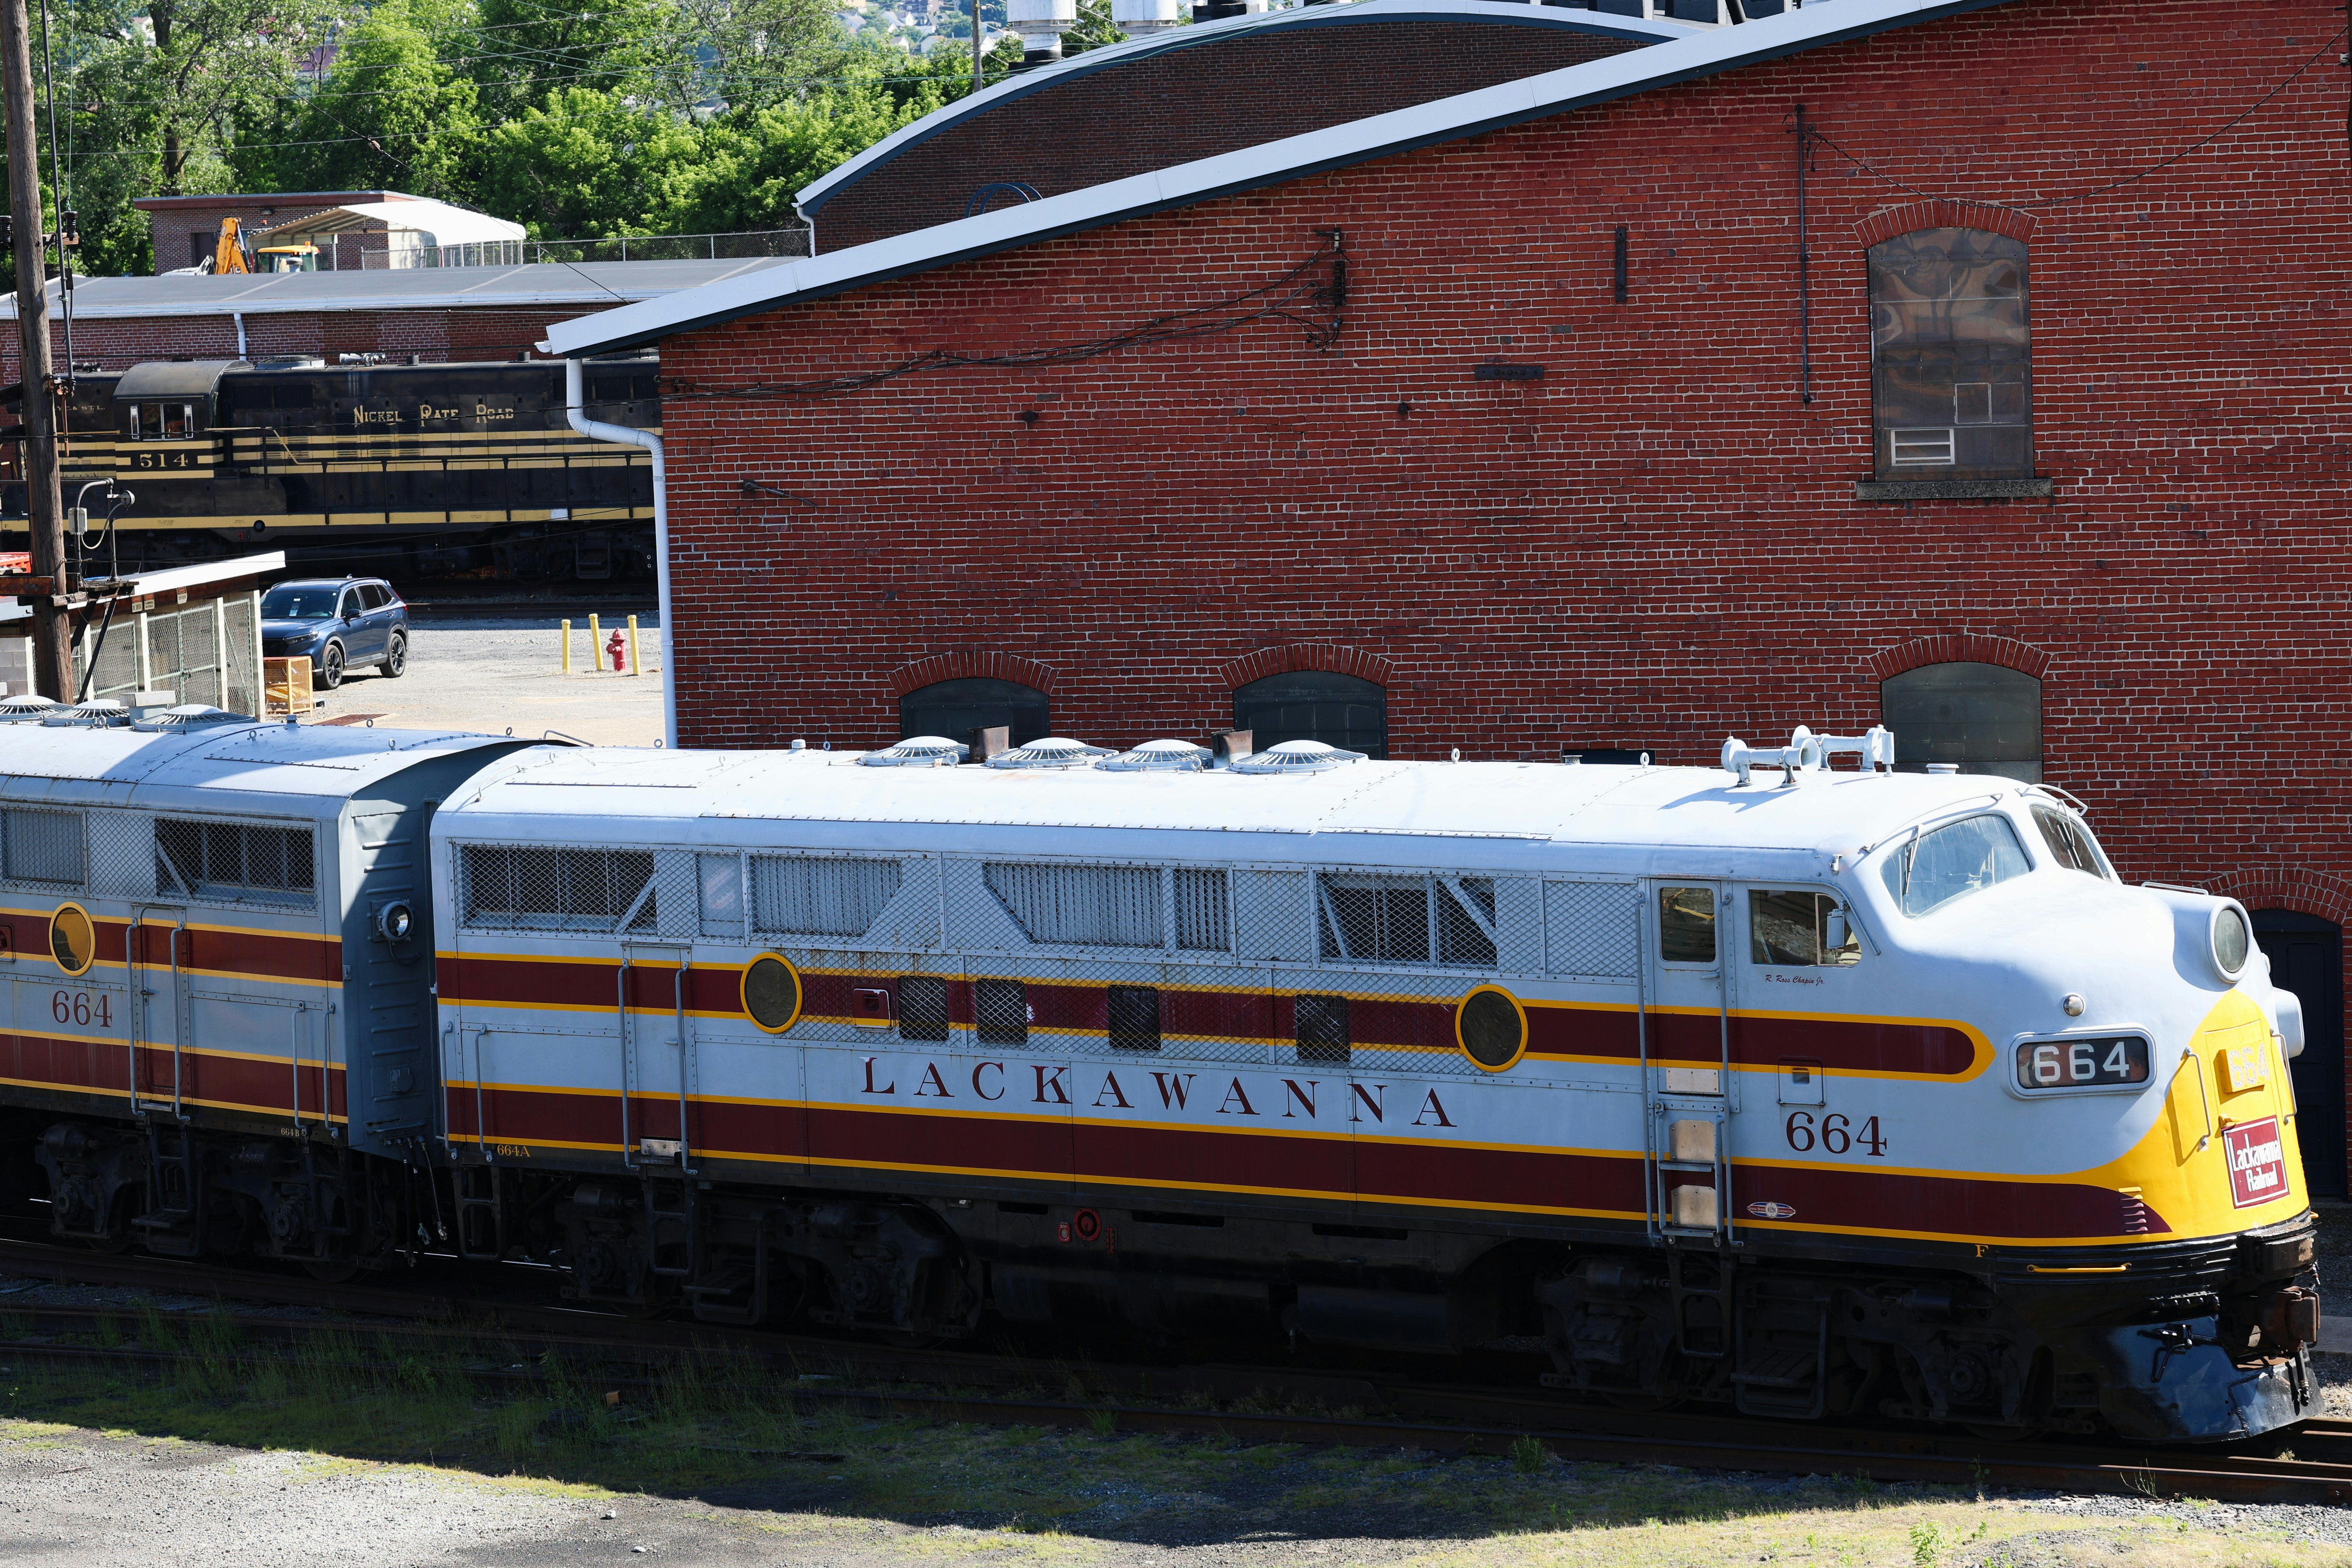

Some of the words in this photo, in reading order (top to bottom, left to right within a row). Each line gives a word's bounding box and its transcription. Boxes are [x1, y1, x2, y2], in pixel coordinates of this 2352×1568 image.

[476, 404, 514, 424] ROAD
[140, 453, 188, 468] 514
[1793, 975, 1814, 986] Chapin
[1816, 977, 1825, 986] Jr.
[53, 990, 112, 1027] 664
[2034, 1041, 2129, 1082] 664
[2229, 1043, 2269, 1088] 664
[860, 1057, 1457, 1128] LACKAWANNA
[497, 1144, 531, 1157] 664A
[1786, 1111, 1887, 1157] 664
[2228, 1133, 2281, 1172] Lackawanna
[2245, 1163, 2278, 1192] Railroad
[1975, 1244, 1988, 1257] F
